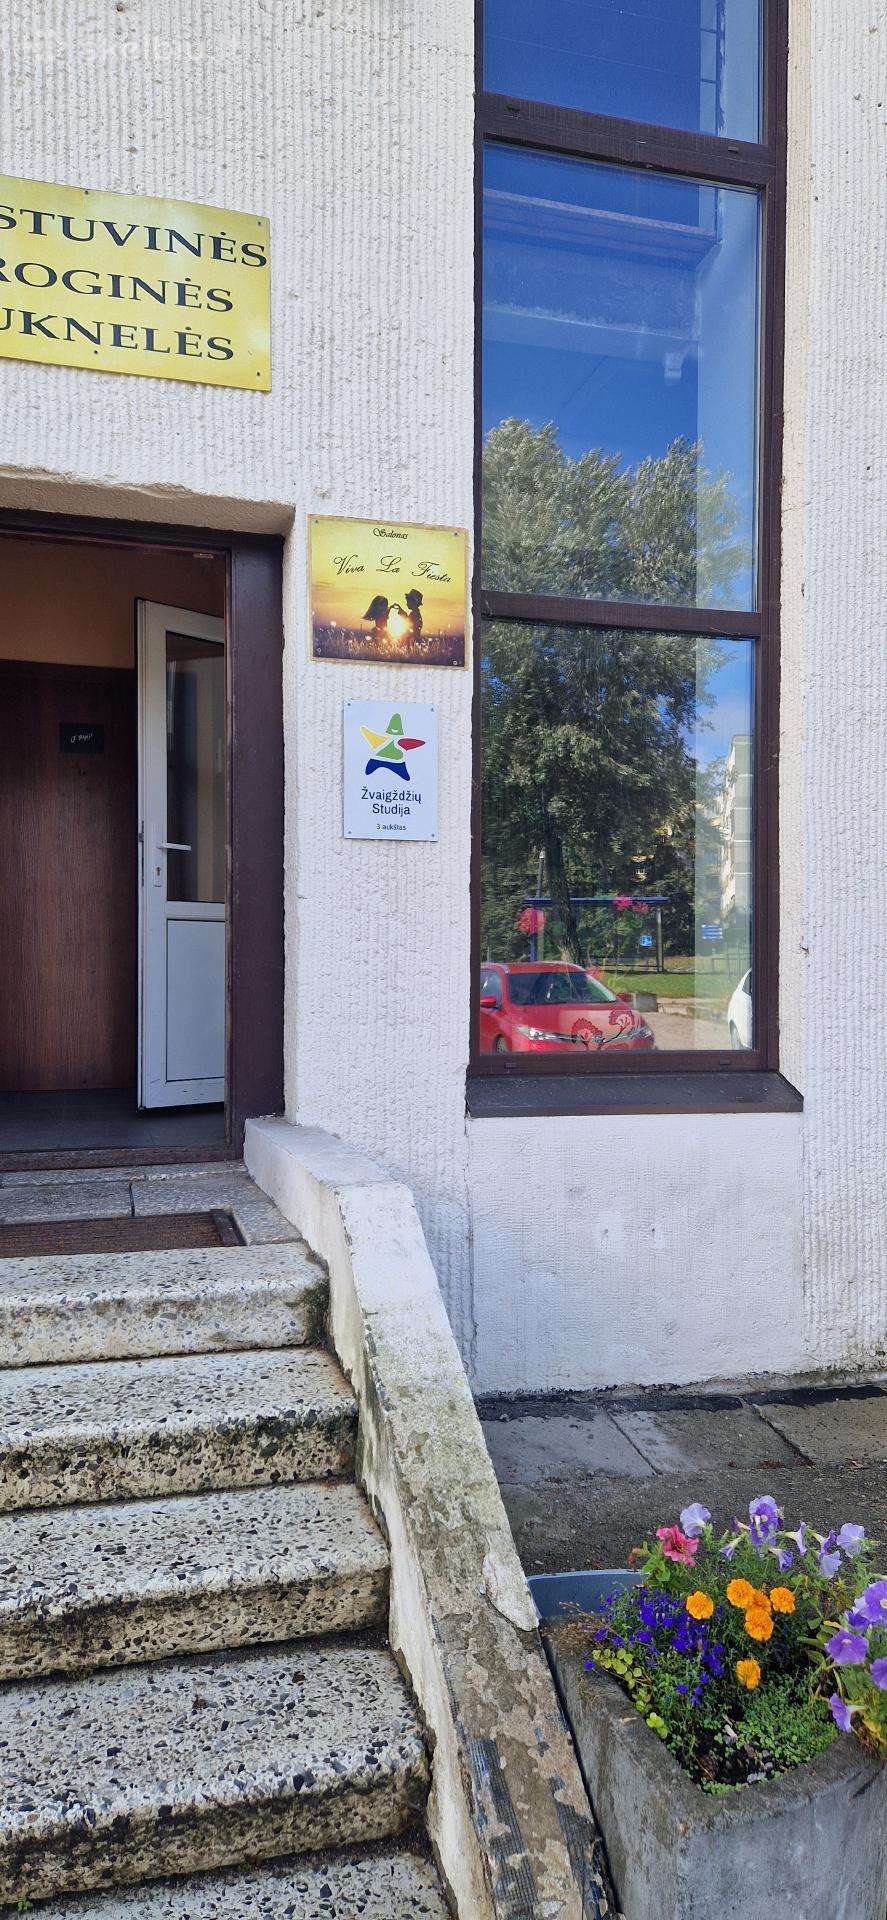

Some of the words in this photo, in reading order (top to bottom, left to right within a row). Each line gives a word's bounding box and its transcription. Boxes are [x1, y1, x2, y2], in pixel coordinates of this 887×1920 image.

[372, 527, 409, 540] Salonas
[333, 554, 365, 576] Viva
[376, 555, 402, 574] La
[411, 561, 453, 583] Fiesta
[361, 786, 422, 805] Žvaigždžių
[372, 803, 411, 818] Studija
[382, 823, 407, 831] aukštas
